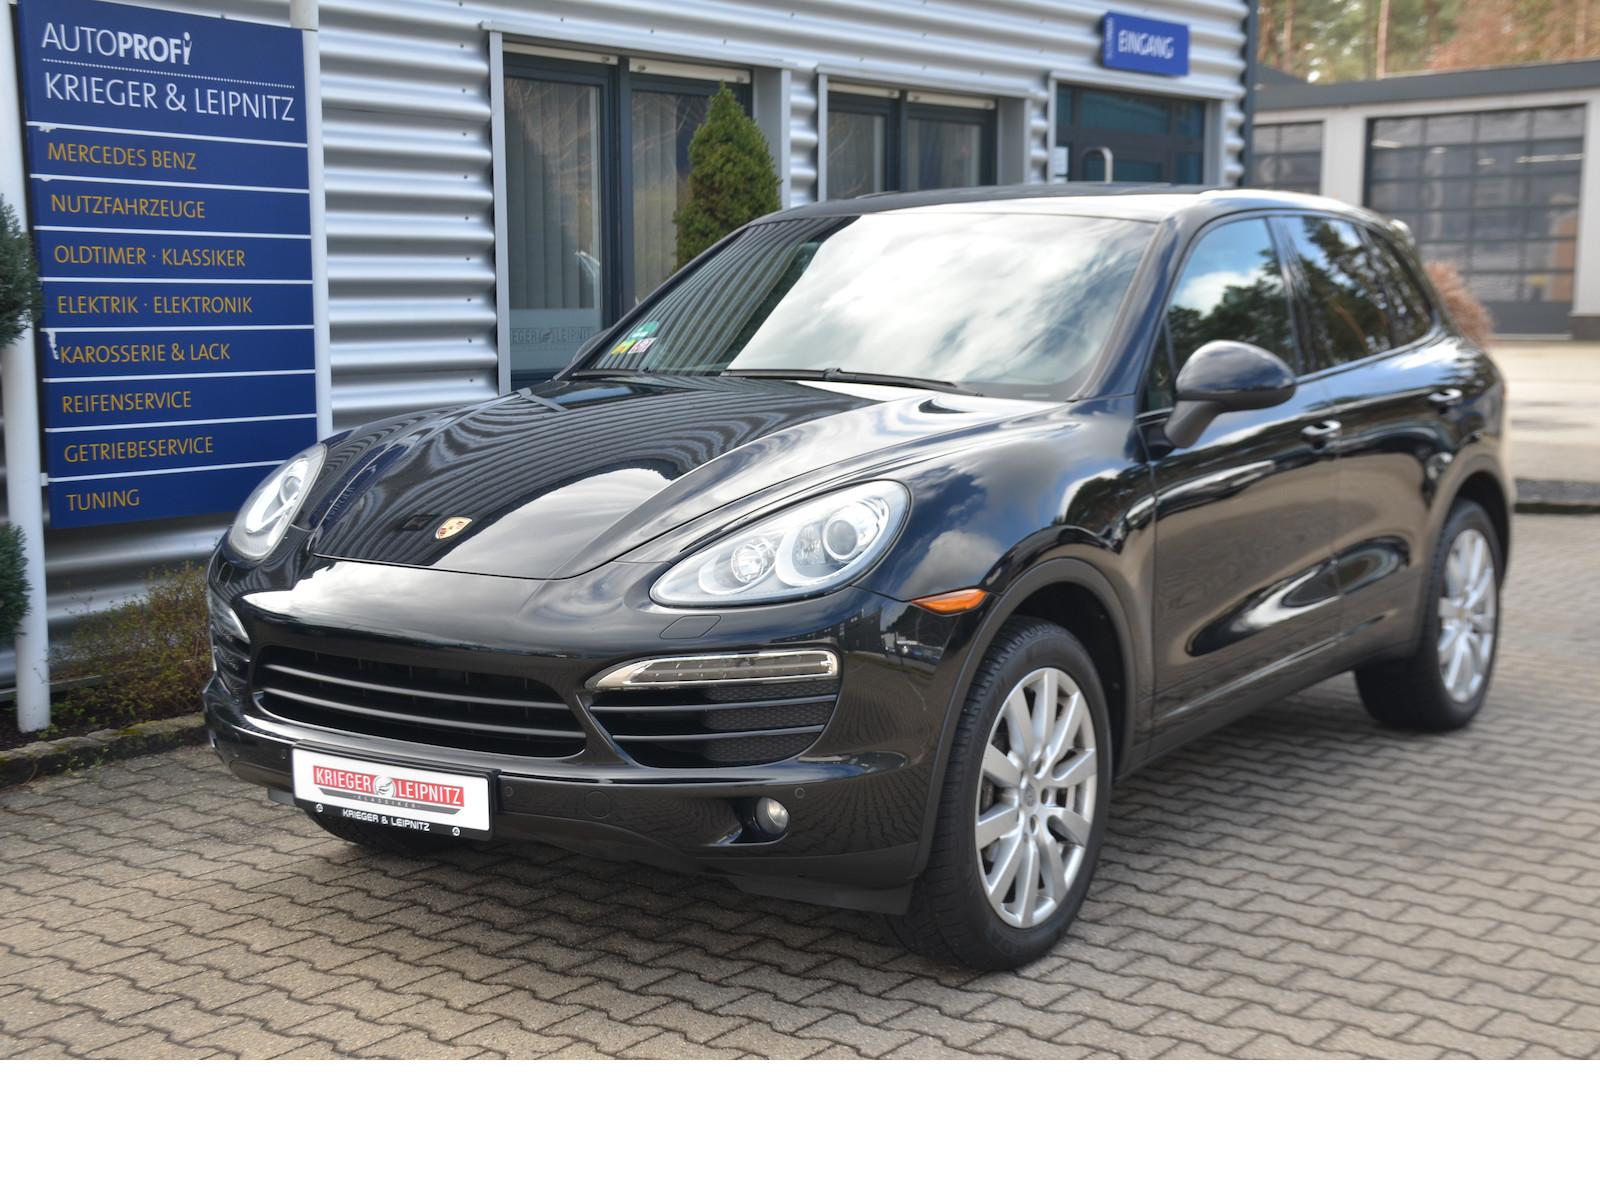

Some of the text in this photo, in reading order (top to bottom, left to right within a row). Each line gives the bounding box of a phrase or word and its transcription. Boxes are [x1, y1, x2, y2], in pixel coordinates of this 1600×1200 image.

[1118, 29, 1174, 59] EINGANG
[45, 72, 295, 122] KRIEGER & LEIPNITZ
[48, 142, 197, 170] MERCEDES BENZ
[51, 194, 206, 218] NUTZFAHRZEUGE
[54, 245, 246, 267] OLDTIMER KLASSIKER
[57, 296, 253, 314] ELEKTRIK ELEKTRONIK
[60, 342, 231, 364] KAROSSERIE & LACK
[62, 391, 192, 413] REIFENSERVICE
[64, 436, 214, 463] GETRIEBESERVICE
[66, 489, 140, 511] TUNING
[316, 769, 462, 805] KRIEGER LEIPNITZ
[342, 809, 430, 831] KRIEGER & LEIPNITZ
